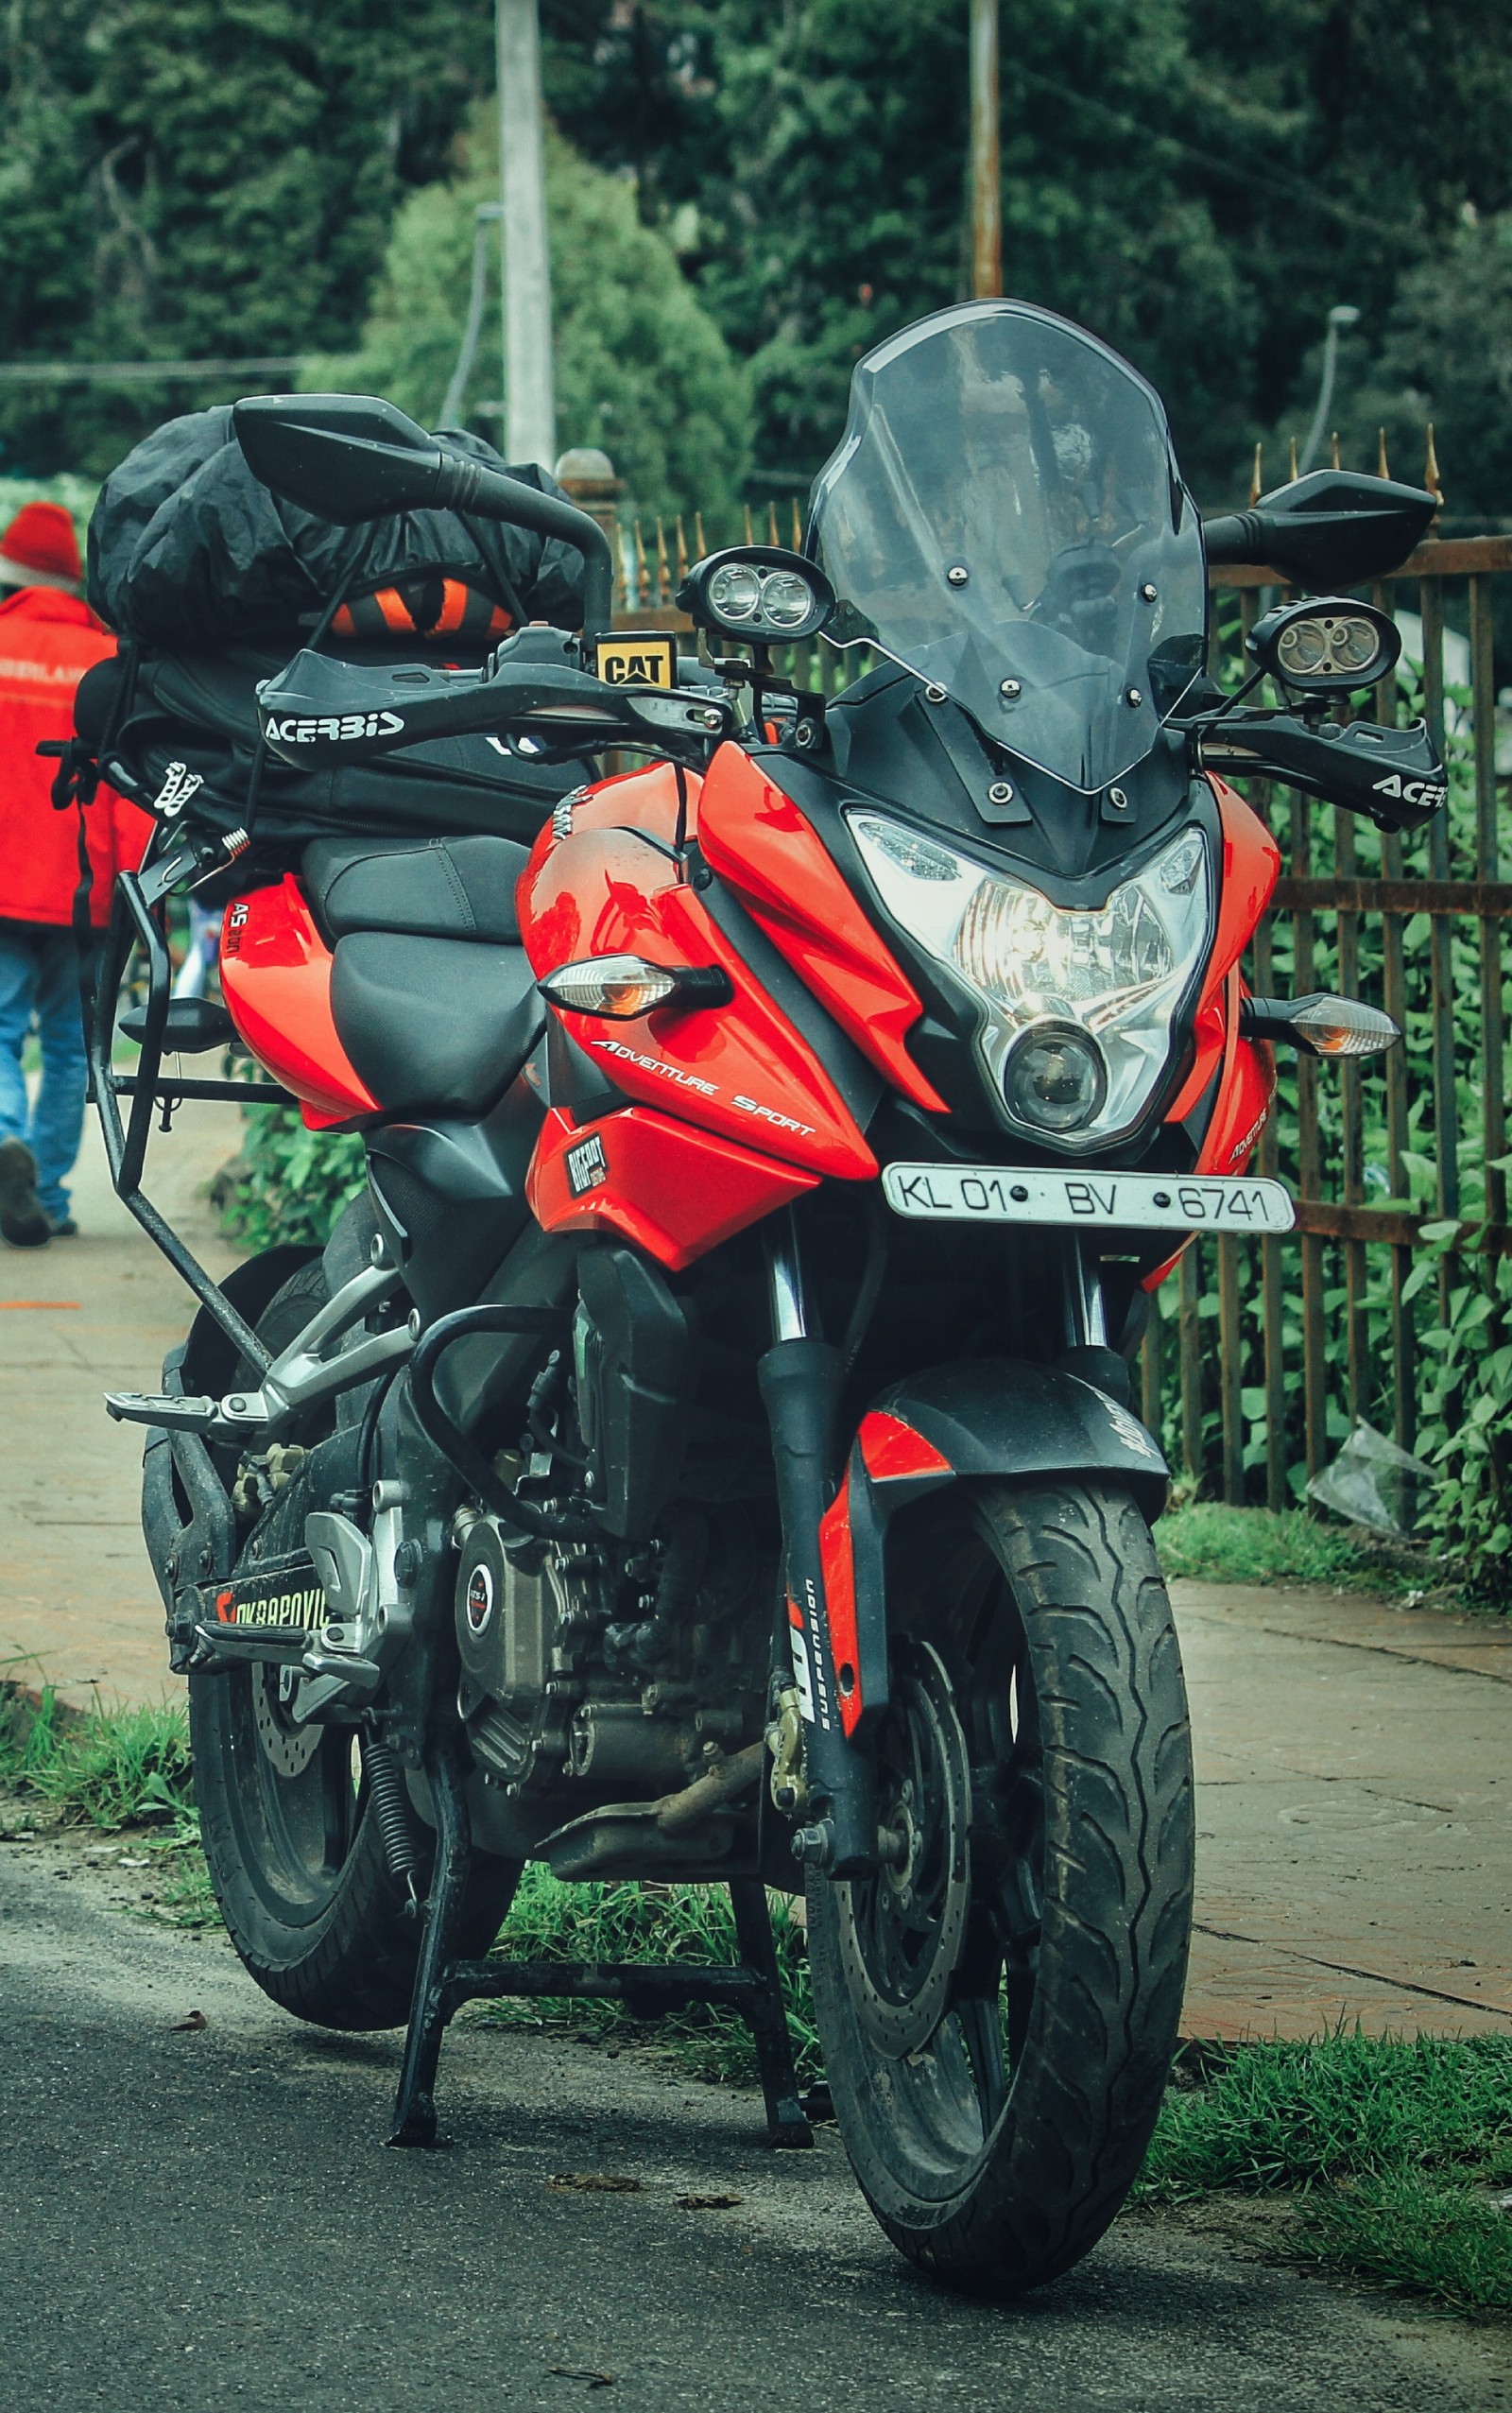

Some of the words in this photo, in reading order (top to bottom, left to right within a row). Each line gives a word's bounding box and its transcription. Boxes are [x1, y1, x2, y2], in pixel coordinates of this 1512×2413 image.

[606, 655, 663, 685] CAT
[591, 1041, 720, 1096] ADVENTURE
[730, 1094, 816, 1136] SPORT
[897, 1175, 954, 1209] KL
[960, 1178, 1007, 1212] 01
[1064, 1181, 1117, 1215] BV
[1178, 1186, 1270, 1222] 6741
